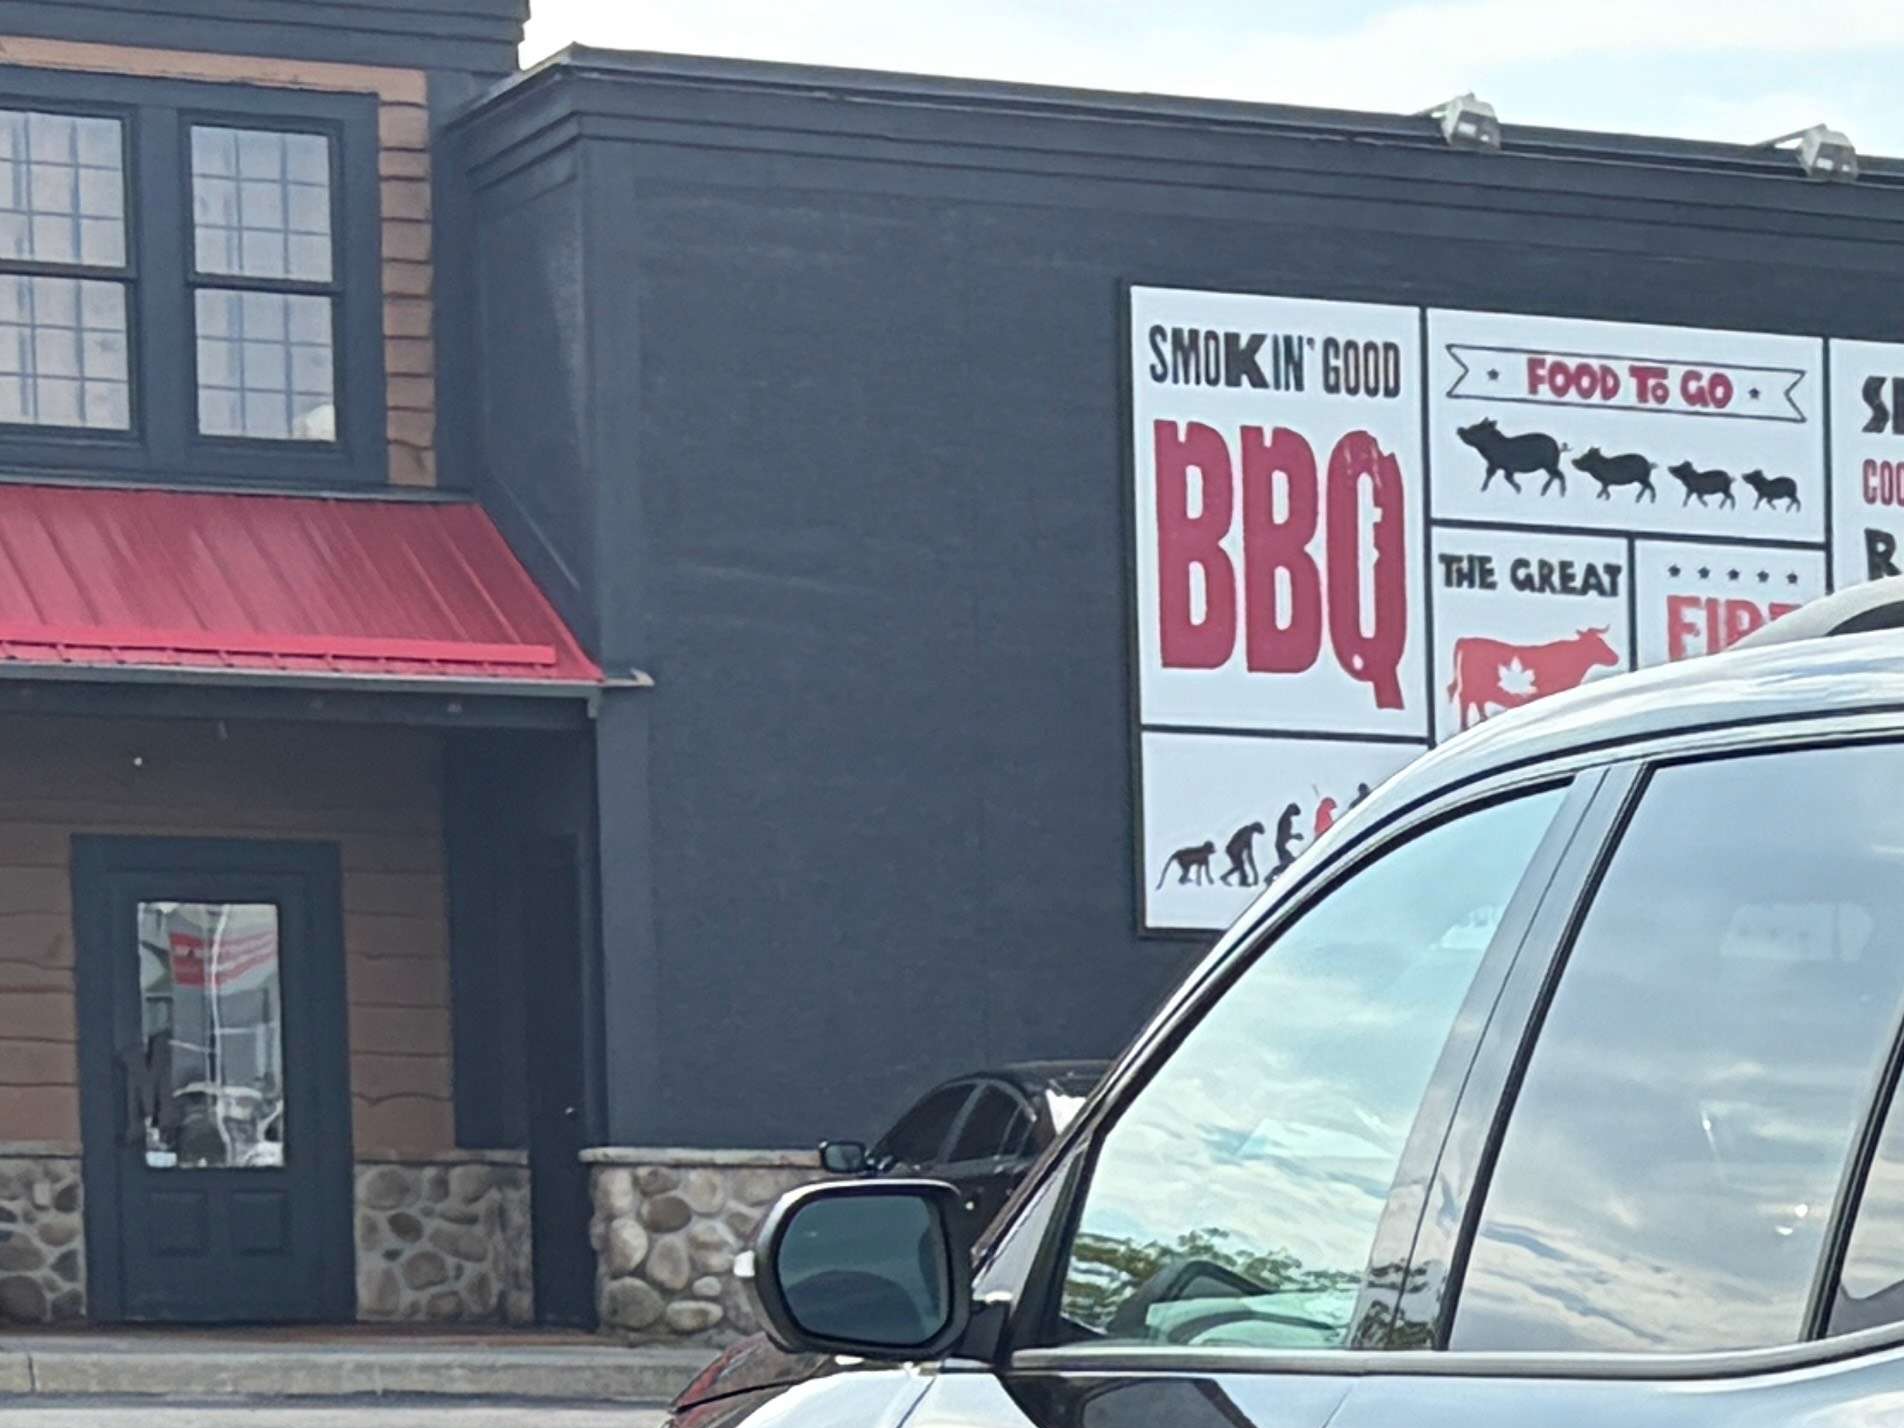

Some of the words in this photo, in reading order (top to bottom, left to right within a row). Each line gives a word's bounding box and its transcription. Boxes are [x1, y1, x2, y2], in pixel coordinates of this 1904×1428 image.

[1149, 324, 1315, 392] SMOKIN'
[1322, 336, 1401, 399] GOOD
[1526, 356, 1621, 402] FOOD
[1680, 369, 1734, 410] GO
[1153, 419, 1406, 710] BBQ
[1438, 553, 1498, 591] THE
[1510, 557, 1622, 598] GREAT
[1666, 594, 1803, 658] FIR
